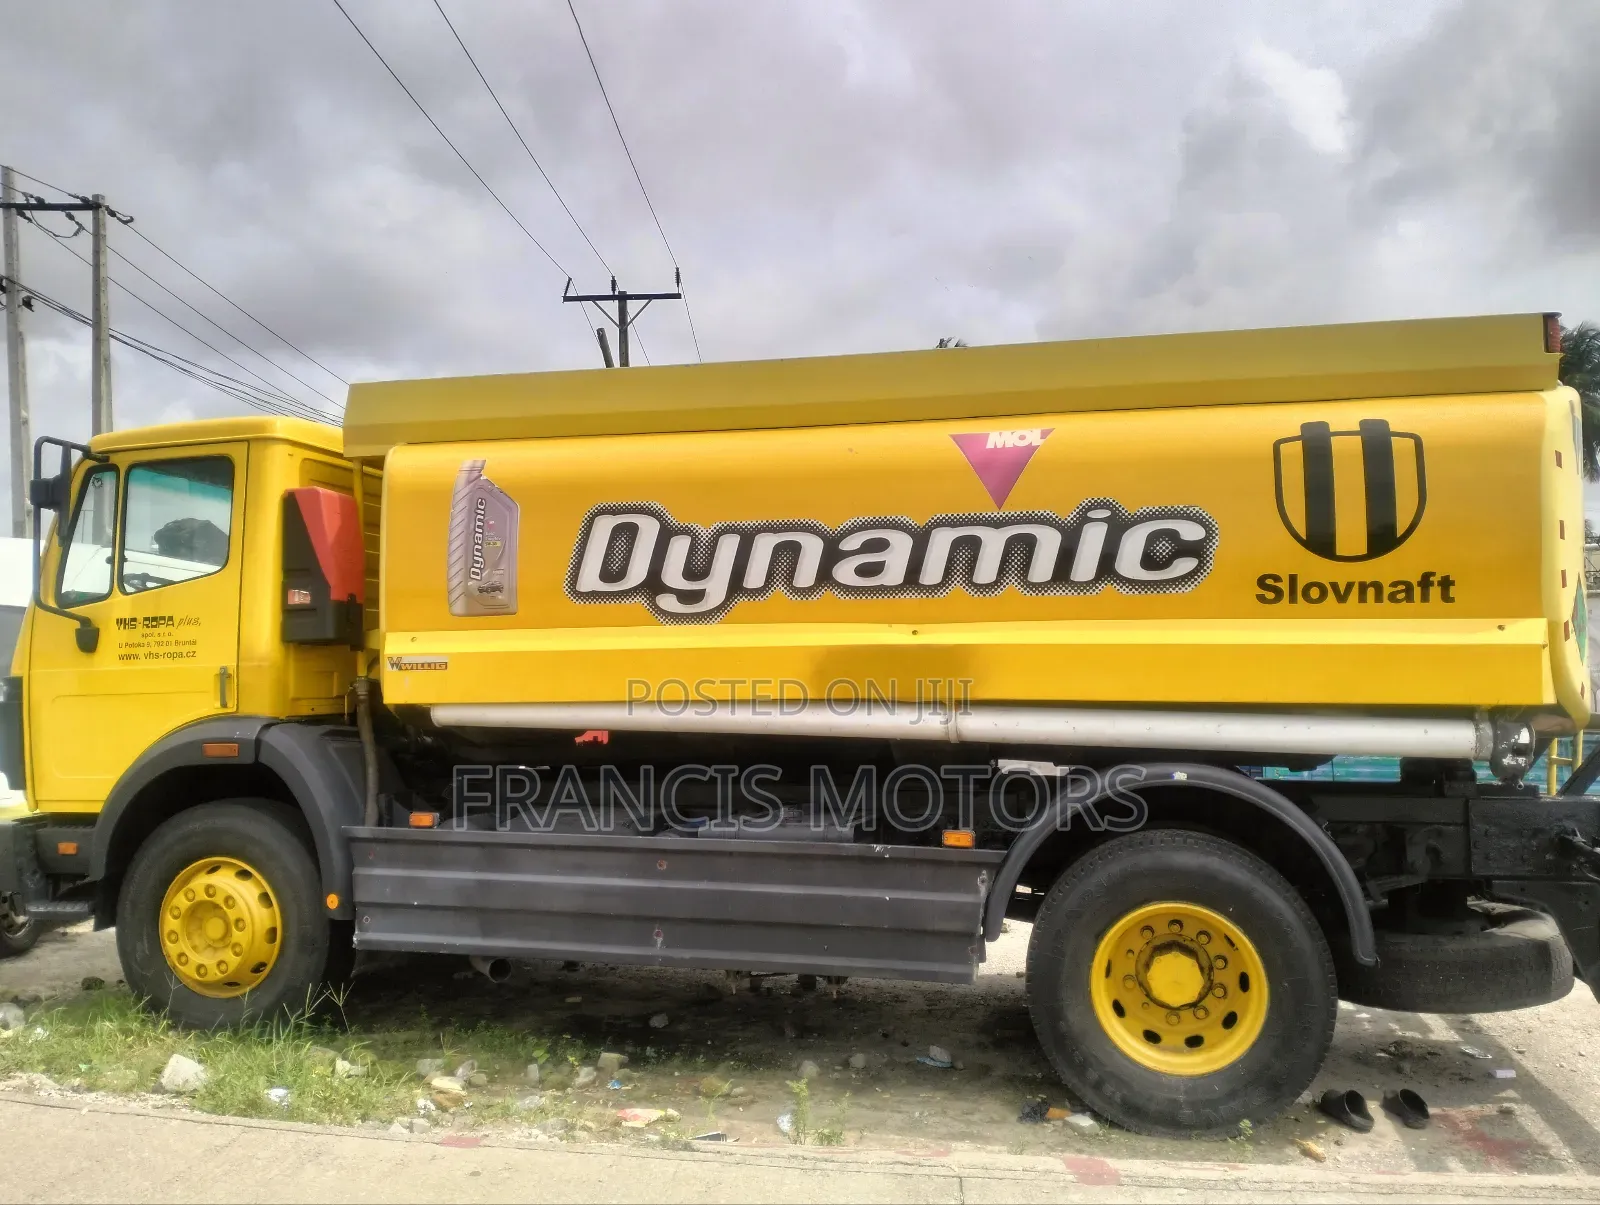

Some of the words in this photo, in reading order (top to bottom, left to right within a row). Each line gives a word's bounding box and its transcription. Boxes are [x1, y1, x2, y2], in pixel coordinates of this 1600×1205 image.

[986, 428, 1047, 449] MOL
[469, 498, 487, 581] Dynamic
[574, 508, 1208, 614] Dynamic
[1255, 571, 1456, 605] Slovnaft
[118, 653, 141, 661] www.
[143, 650, 197, 661] vhs-ropa.cz
